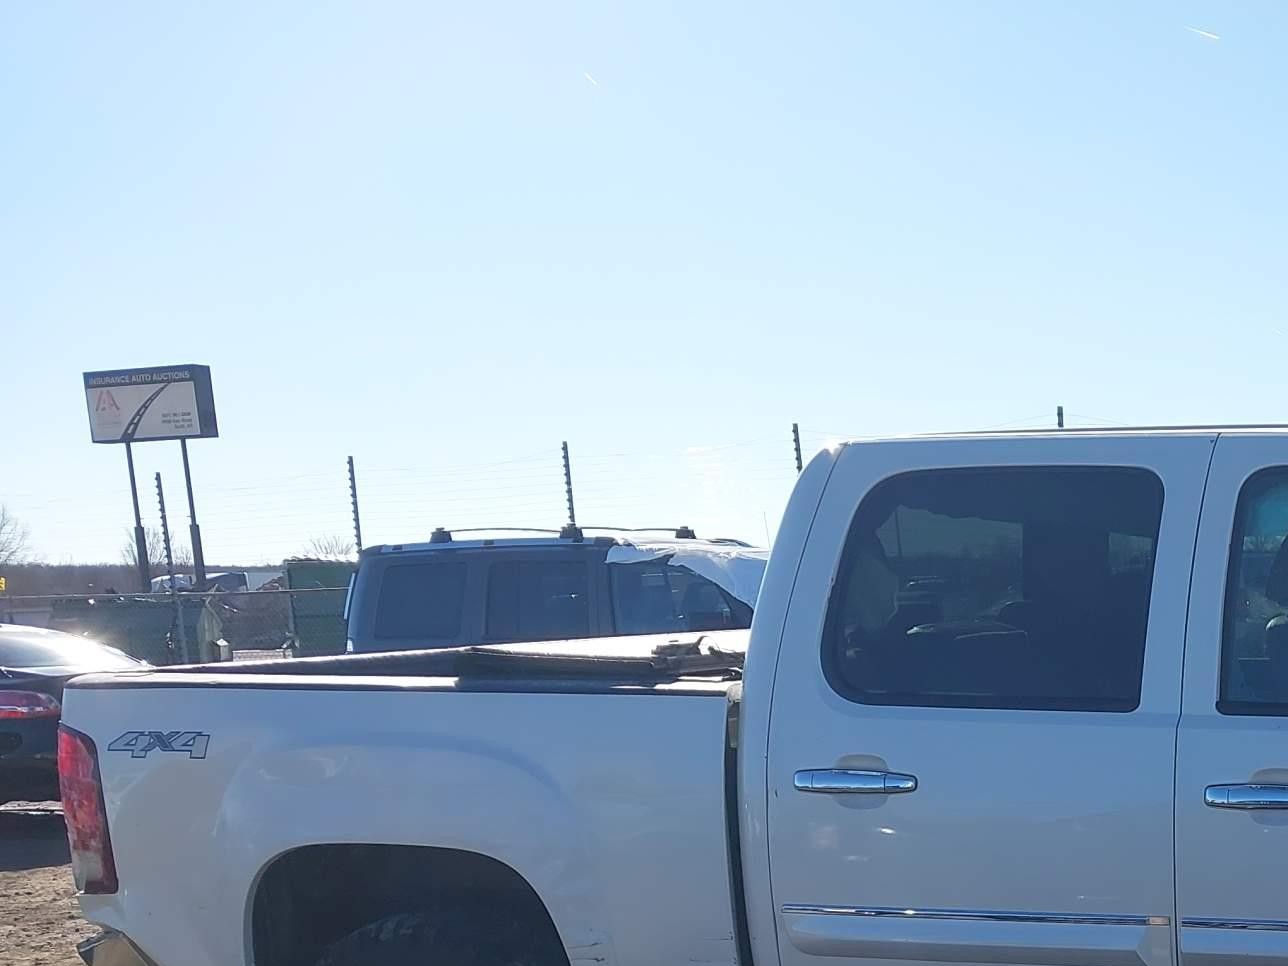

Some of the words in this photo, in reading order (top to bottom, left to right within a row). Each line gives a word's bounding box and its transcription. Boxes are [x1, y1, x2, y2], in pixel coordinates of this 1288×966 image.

[88, 376, 129, 385] INSURANCE
[131, 373, 152, 383] AUTO
[153, 370, 190, 381] AUCTIONS
